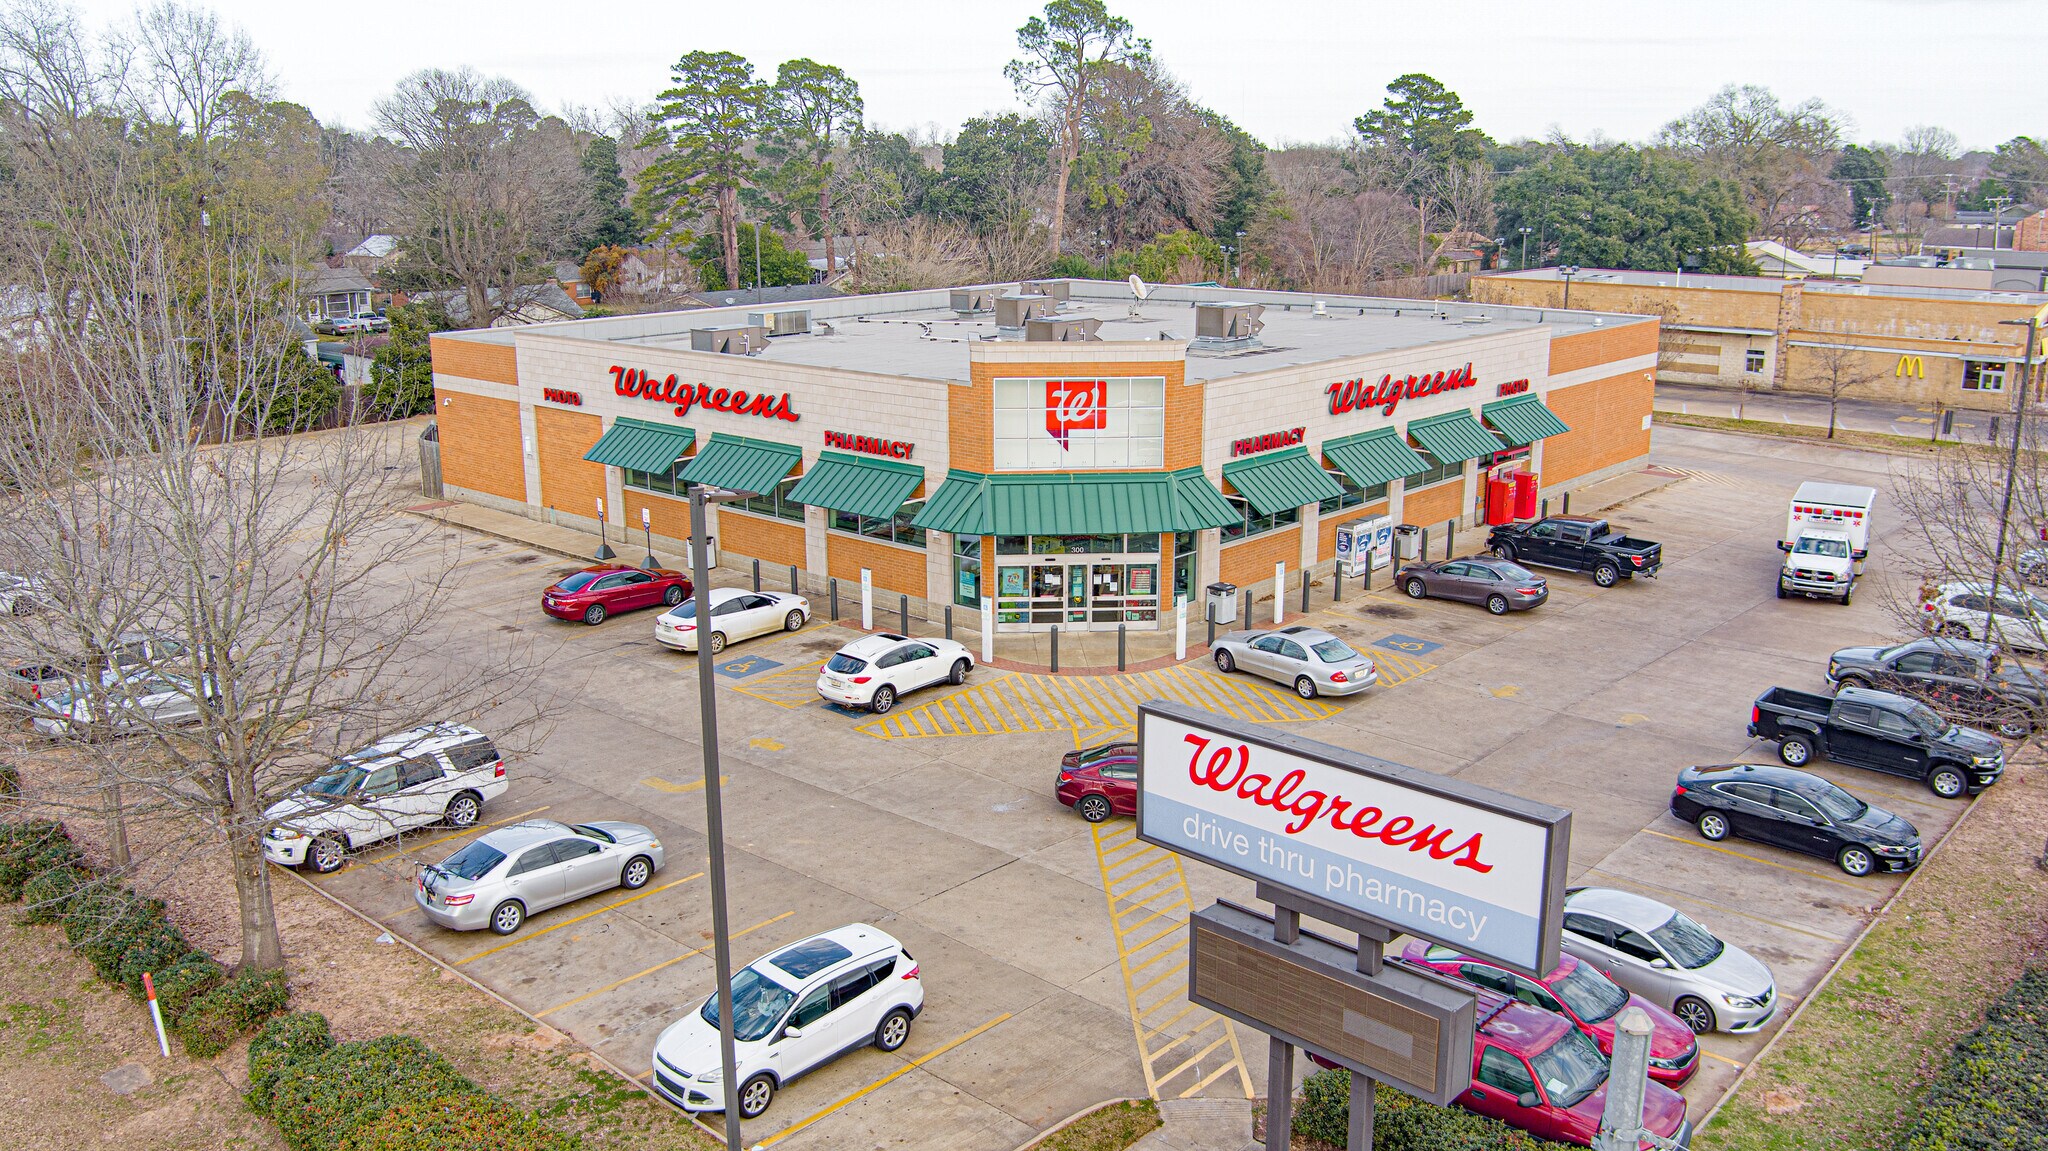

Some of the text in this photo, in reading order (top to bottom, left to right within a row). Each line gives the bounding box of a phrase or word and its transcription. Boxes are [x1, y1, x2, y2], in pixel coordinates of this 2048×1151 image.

[1896, 355, 1924, 379] M
[543, 387, 582, 406] PHOTO
[609, 365, 799, 422] Walgreens
[1327, 362, 1477, 416] Walgreens
[1498, 378, 1529, 398] PHOTO
[824, 430, 914, 460] PHARMACY
[1232, 427, 1307, 458] PHARMACY
[1071, 546, 1085, 554] 300
[1184, 733, 1493, 874] Walgreens
[1183, 813, 1488, 942] drive thru pharmacy
